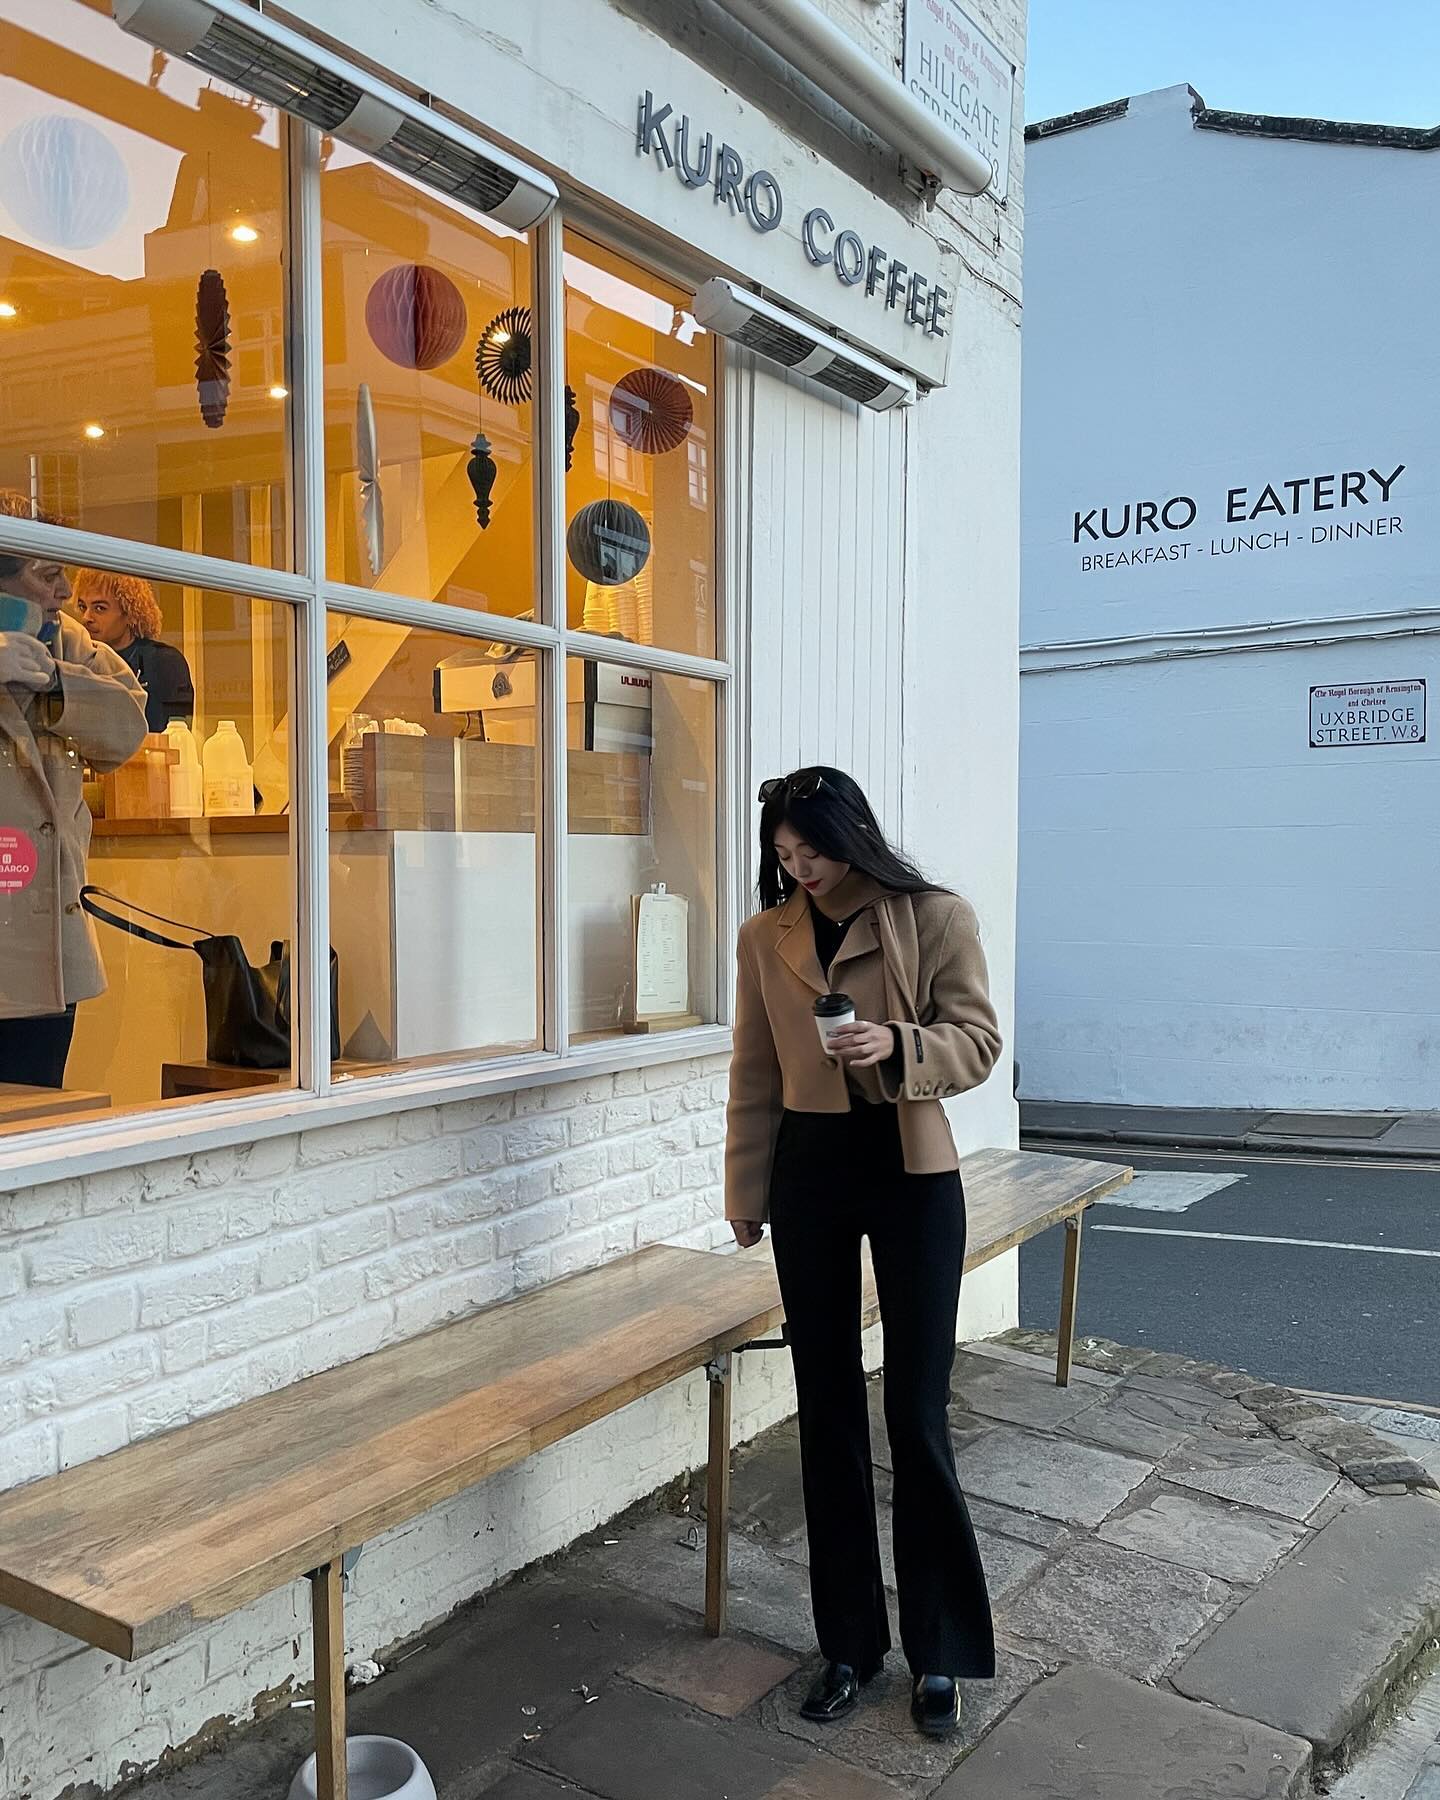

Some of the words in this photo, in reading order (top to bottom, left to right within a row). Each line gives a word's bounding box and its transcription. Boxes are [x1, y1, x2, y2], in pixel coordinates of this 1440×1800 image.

[920, 41, 1000, 149] HILLGATE
[640, 90, 783, 232] KURO
[803, 207, 948, 337] COFFEE
[1073, 496, 1198, 544] KURO
[1226, 464, 1406, 523] EATERY
[1081, 543, 1191, 572] BREAKFAST
[1211, 531, 1289, 556] LUNCH
[1311, 516, 1403, 544] DINNER
[1314, 690, 1326, 698] The
[1329, 688, 1347, 698] Royal
[1348, 687, 1375, 696] Borough
[1377, 685, 1384, 693] of
[1385, 684, 1421, 694] Kensington
[1320, 707, 1415, 726] UXBRIDGE
[1348, 699, 1359, 707] and
[1361, 698, 1387, 707] Chelsea
